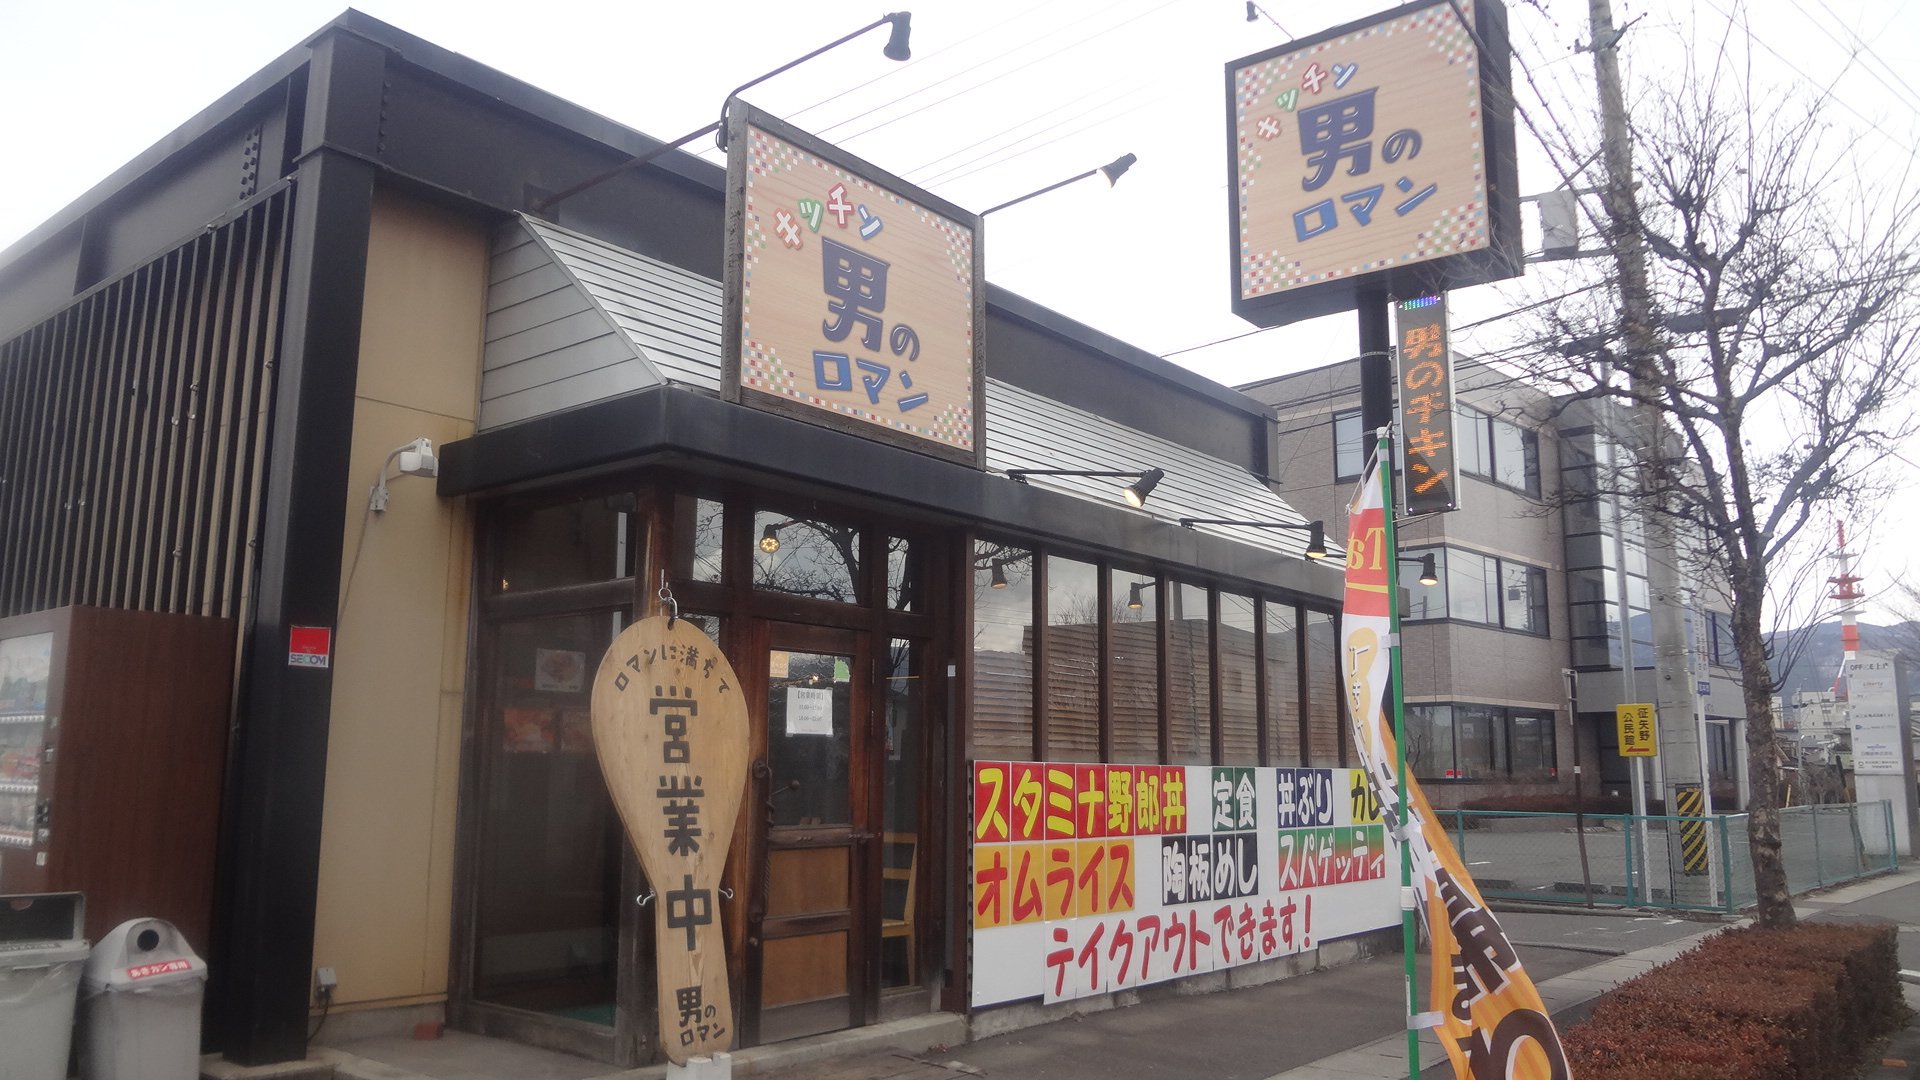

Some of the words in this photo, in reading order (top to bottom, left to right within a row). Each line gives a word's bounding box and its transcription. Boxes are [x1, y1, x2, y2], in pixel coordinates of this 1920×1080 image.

[1297, 86, 1422, 192] 男の
[1293, 176, 1437, 242] ロマン
[821, 235, 920, 361] 男の
[812, 350, 929, 412] ロマン
[1403, 322, 1448, 494] 男のチキン
[290, 653, 327, 666] SECOM
[614, 643, 731, 693] ロマンに満ちて
[1623, 712, 1635, 746] 公民館
[649, 685, 712, 951] 営業中
[976, 767, 1187, 840] スタミナ野郎丼
[1212, 768, 1256, 830] 定食
[1278, 771, 1333, 827] 丼ぶり
[976, 838, 1134, 925] オムライス
[1162, 833, 1258, 904] 陶板めし
[1279, 830, 1385, 890] スパゲッティ
[675, 985, 716, 1027] 男の
[680, 1022, 726, 1046] ロマン
